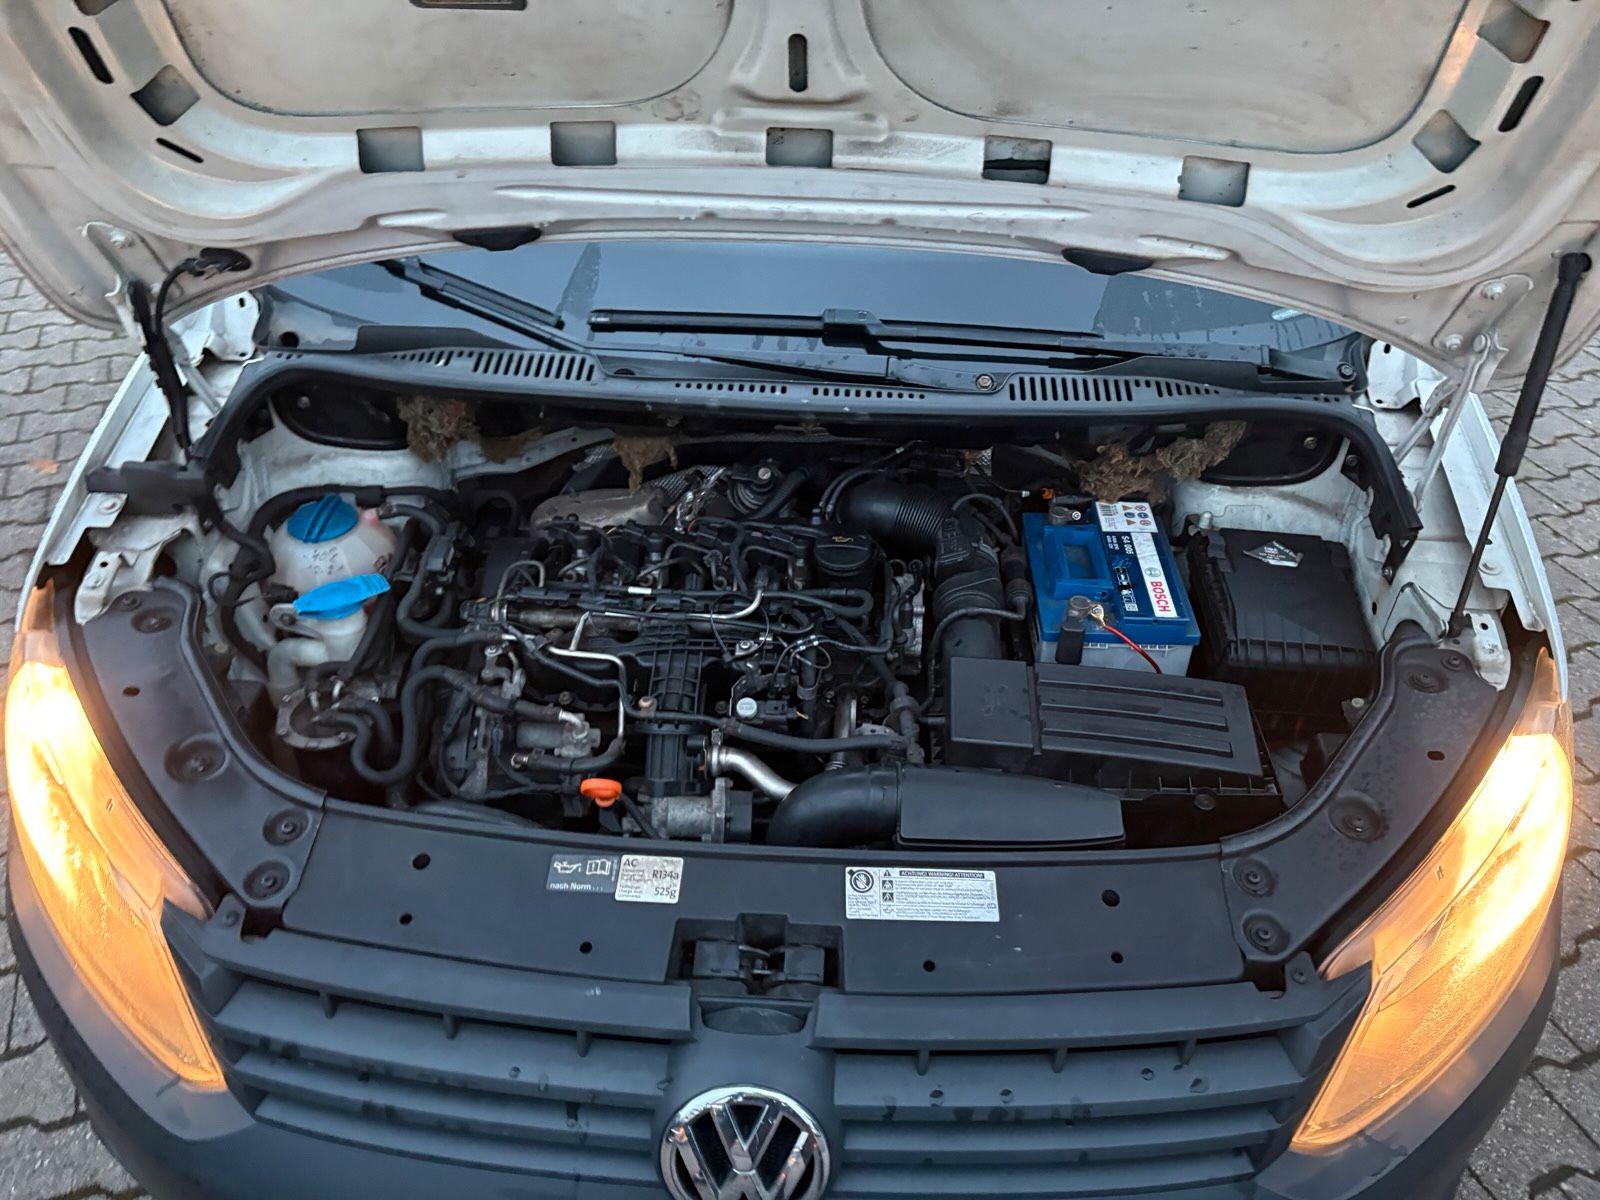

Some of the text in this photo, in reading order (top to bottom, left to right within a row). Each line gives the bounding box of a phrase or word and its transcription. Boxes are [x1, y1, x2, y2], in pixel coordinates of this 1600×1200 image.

[1150, 580, 1171, 613] BOSCH
[623, 858, 639, 867] AC
[652, 869, 679, 880] R134a
[549, 882, 569, 890] nach
[654, 887, 676, 899] 525g
